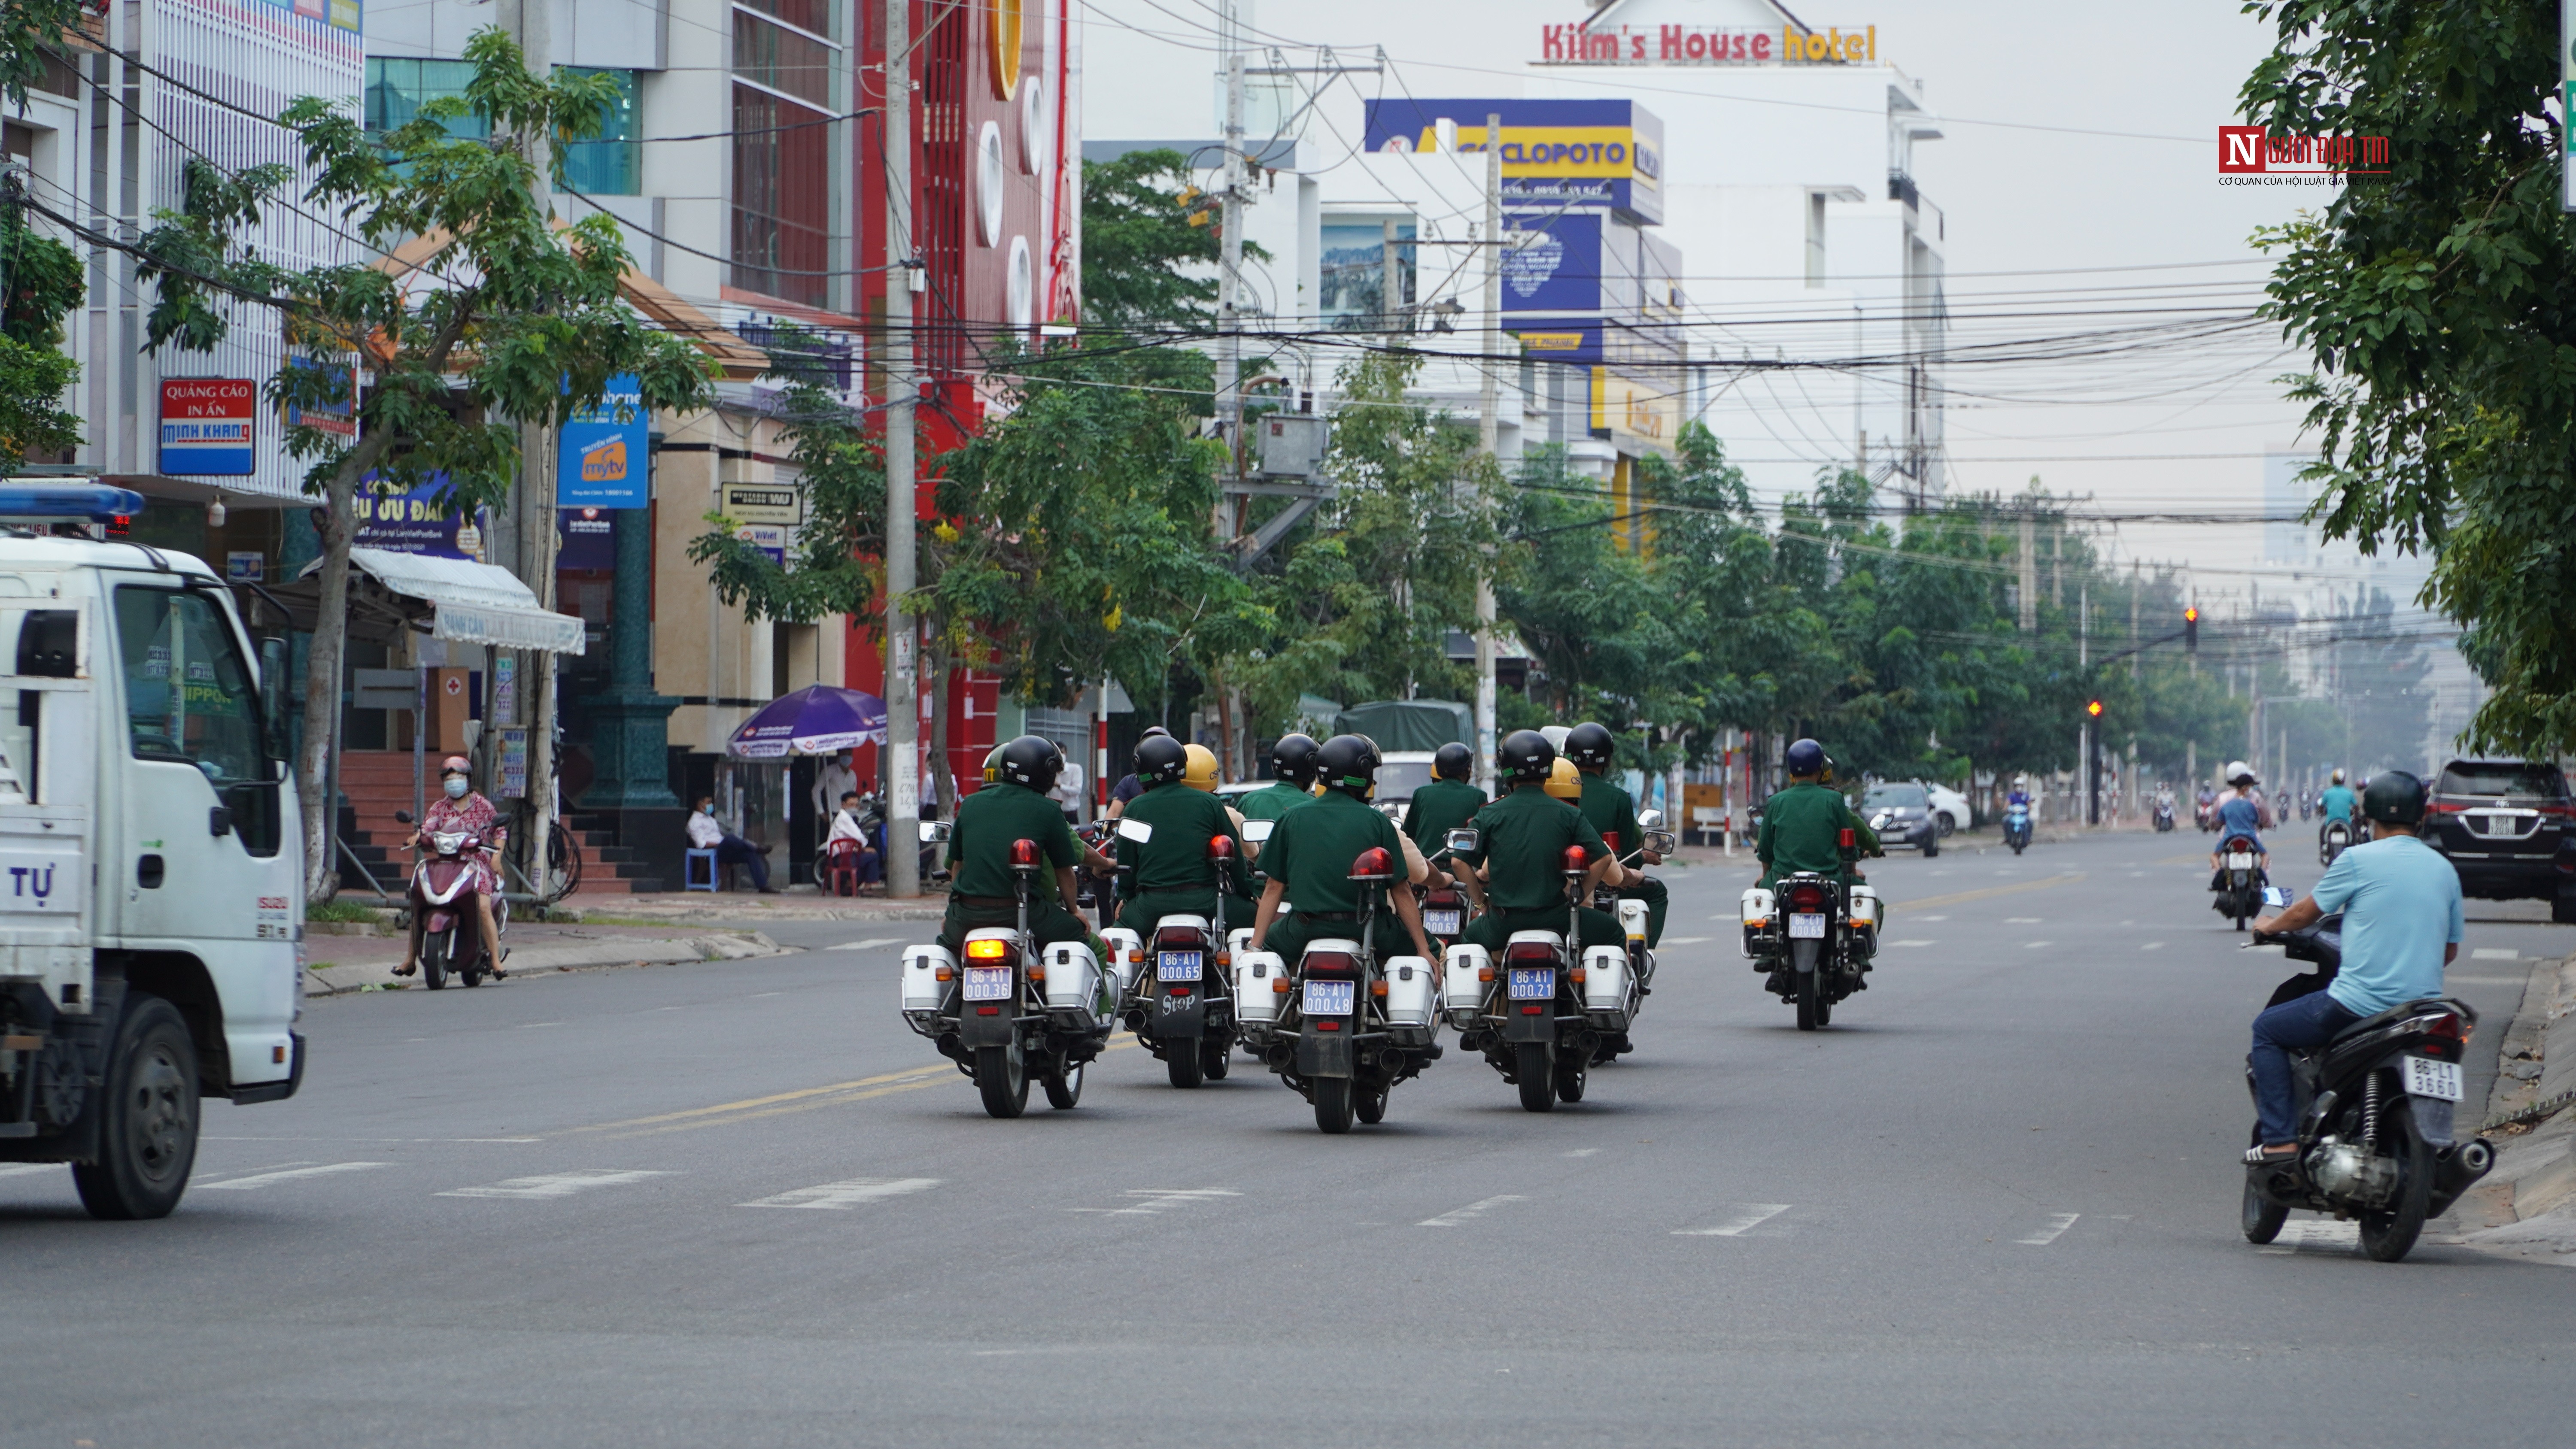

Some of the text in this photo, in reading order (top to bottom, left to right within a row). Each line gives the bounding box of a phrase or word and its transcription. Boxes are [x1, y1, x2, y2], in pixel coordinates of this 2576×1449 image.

[1543, 23, 1875, 61] Kiim's House hotel
[166, 382, 248, 400] QUẢNG CÁO
[188, 400, 225, 416] IN ẤN
[8, 861, 56, 907] TỰ
[1430, 911, 1454, 922] 86-A1
[1795, 915, 1819, 926] 86-C1
[1425, 922, 1457, 933] 000.63
[1791, 925, 1823, 936] 000.65
[1165, 953, 1195, 966] 86-A1
[971, 969, 1004, 984] 86-A1
[1160, 966, 1200, 979] 000.65
[1516, 970, 1547, 984] 86-A1
[966, 983, 1009, 998] 000.36
[1312, 982, 1346, 997] 86-A1
[1511, 983, 1551, 997] 000.21
[1306, 997, 1350, 1012] 000.48
[2414, 1059, 2453, 1080] 86-L1
[2415, 1076, 2456, 1097] 3660
